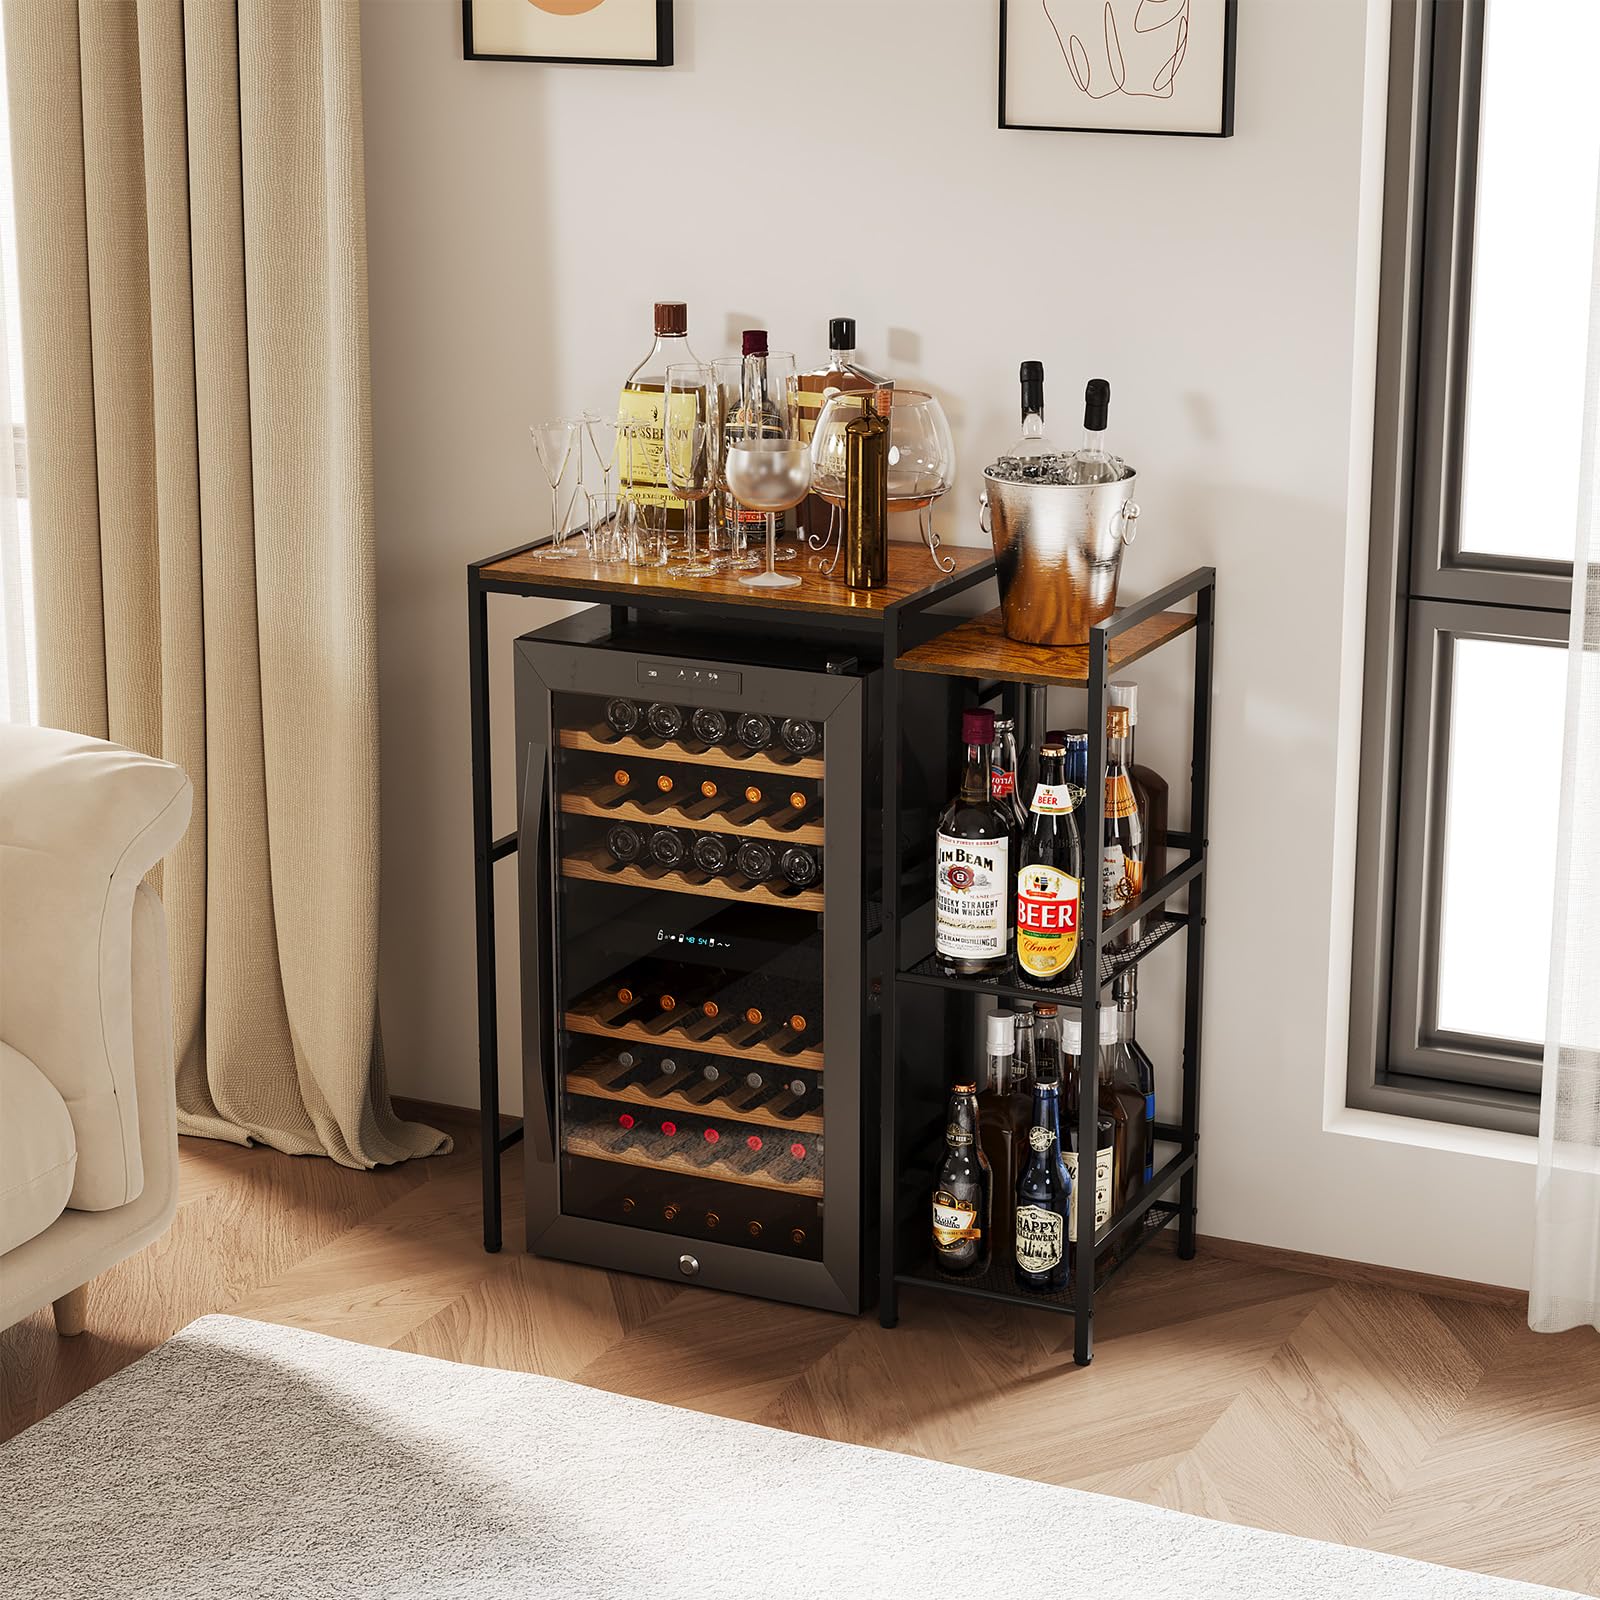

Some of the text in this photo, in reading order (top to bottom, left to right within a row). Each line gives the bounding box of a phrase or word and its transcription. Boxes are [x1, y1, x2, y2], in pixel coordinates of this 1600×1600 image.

[1037, 795, 1058, 805] BEER
[938, 847, 993, 872] JIM BEAM
[962, 899, 999, 909] STRAIGHT
[962, 908, 994, 917] WHISKEY
[1018, 898, 1075, 928] BEER
[1017, 1214, 1057, 1234] HAPPY
